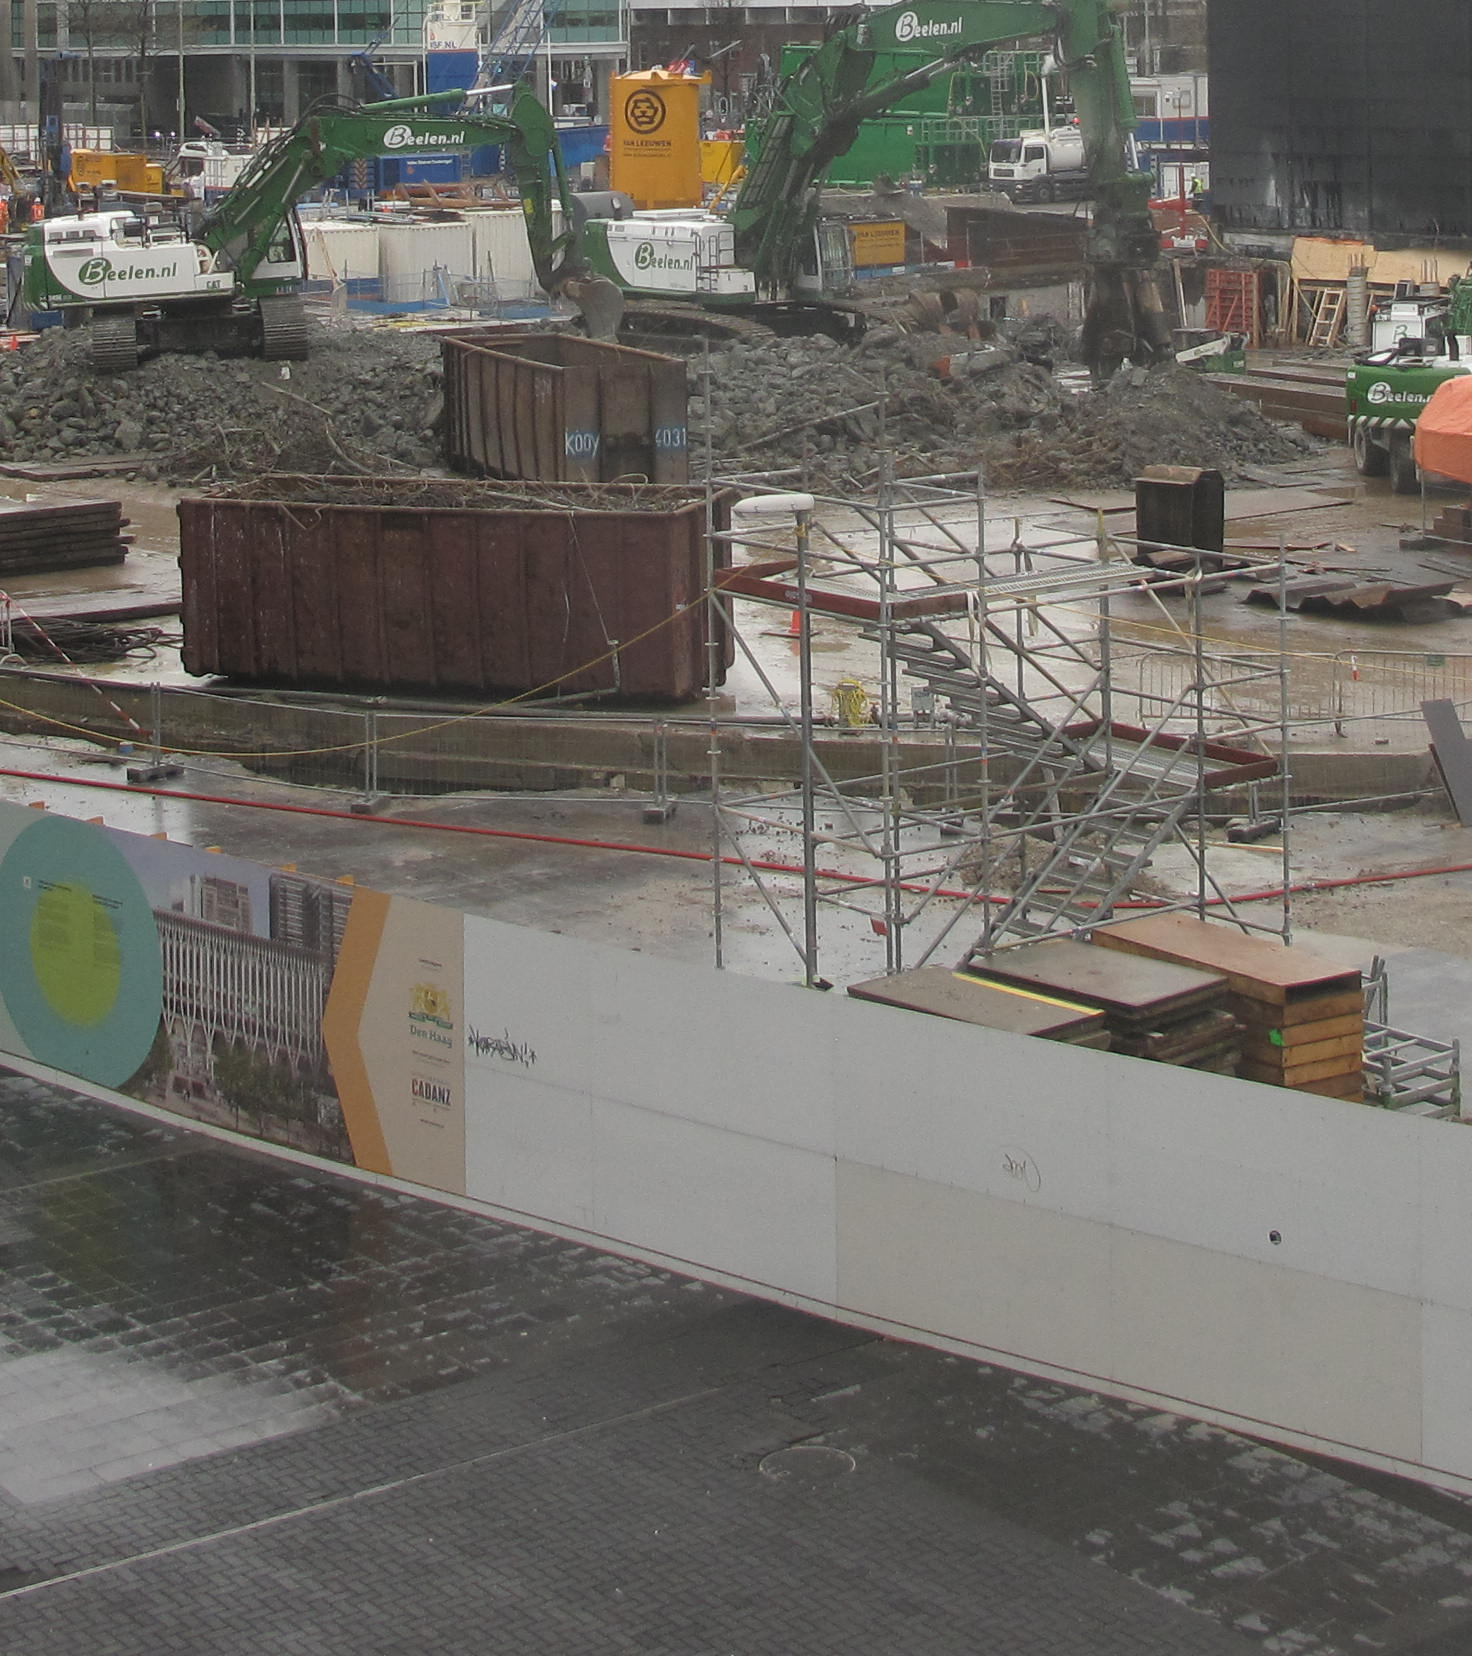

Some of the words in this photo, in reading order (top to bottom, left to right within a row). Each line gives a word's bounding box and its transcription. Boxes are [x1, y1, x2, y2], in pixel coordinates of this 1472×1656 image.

[895, 11, 963, 42] Beelen.nl
[383, 124, 465, 148] Beelen.nl
[78, 256, 177, 285] Beelen.nl
[634, 241, 694, 271] Beelen.nl
[409, 1023, 429, 1040] Den
[429, 1030, 453, 1049] Haag
[411, 1078, 452, 1107] CADANZ
